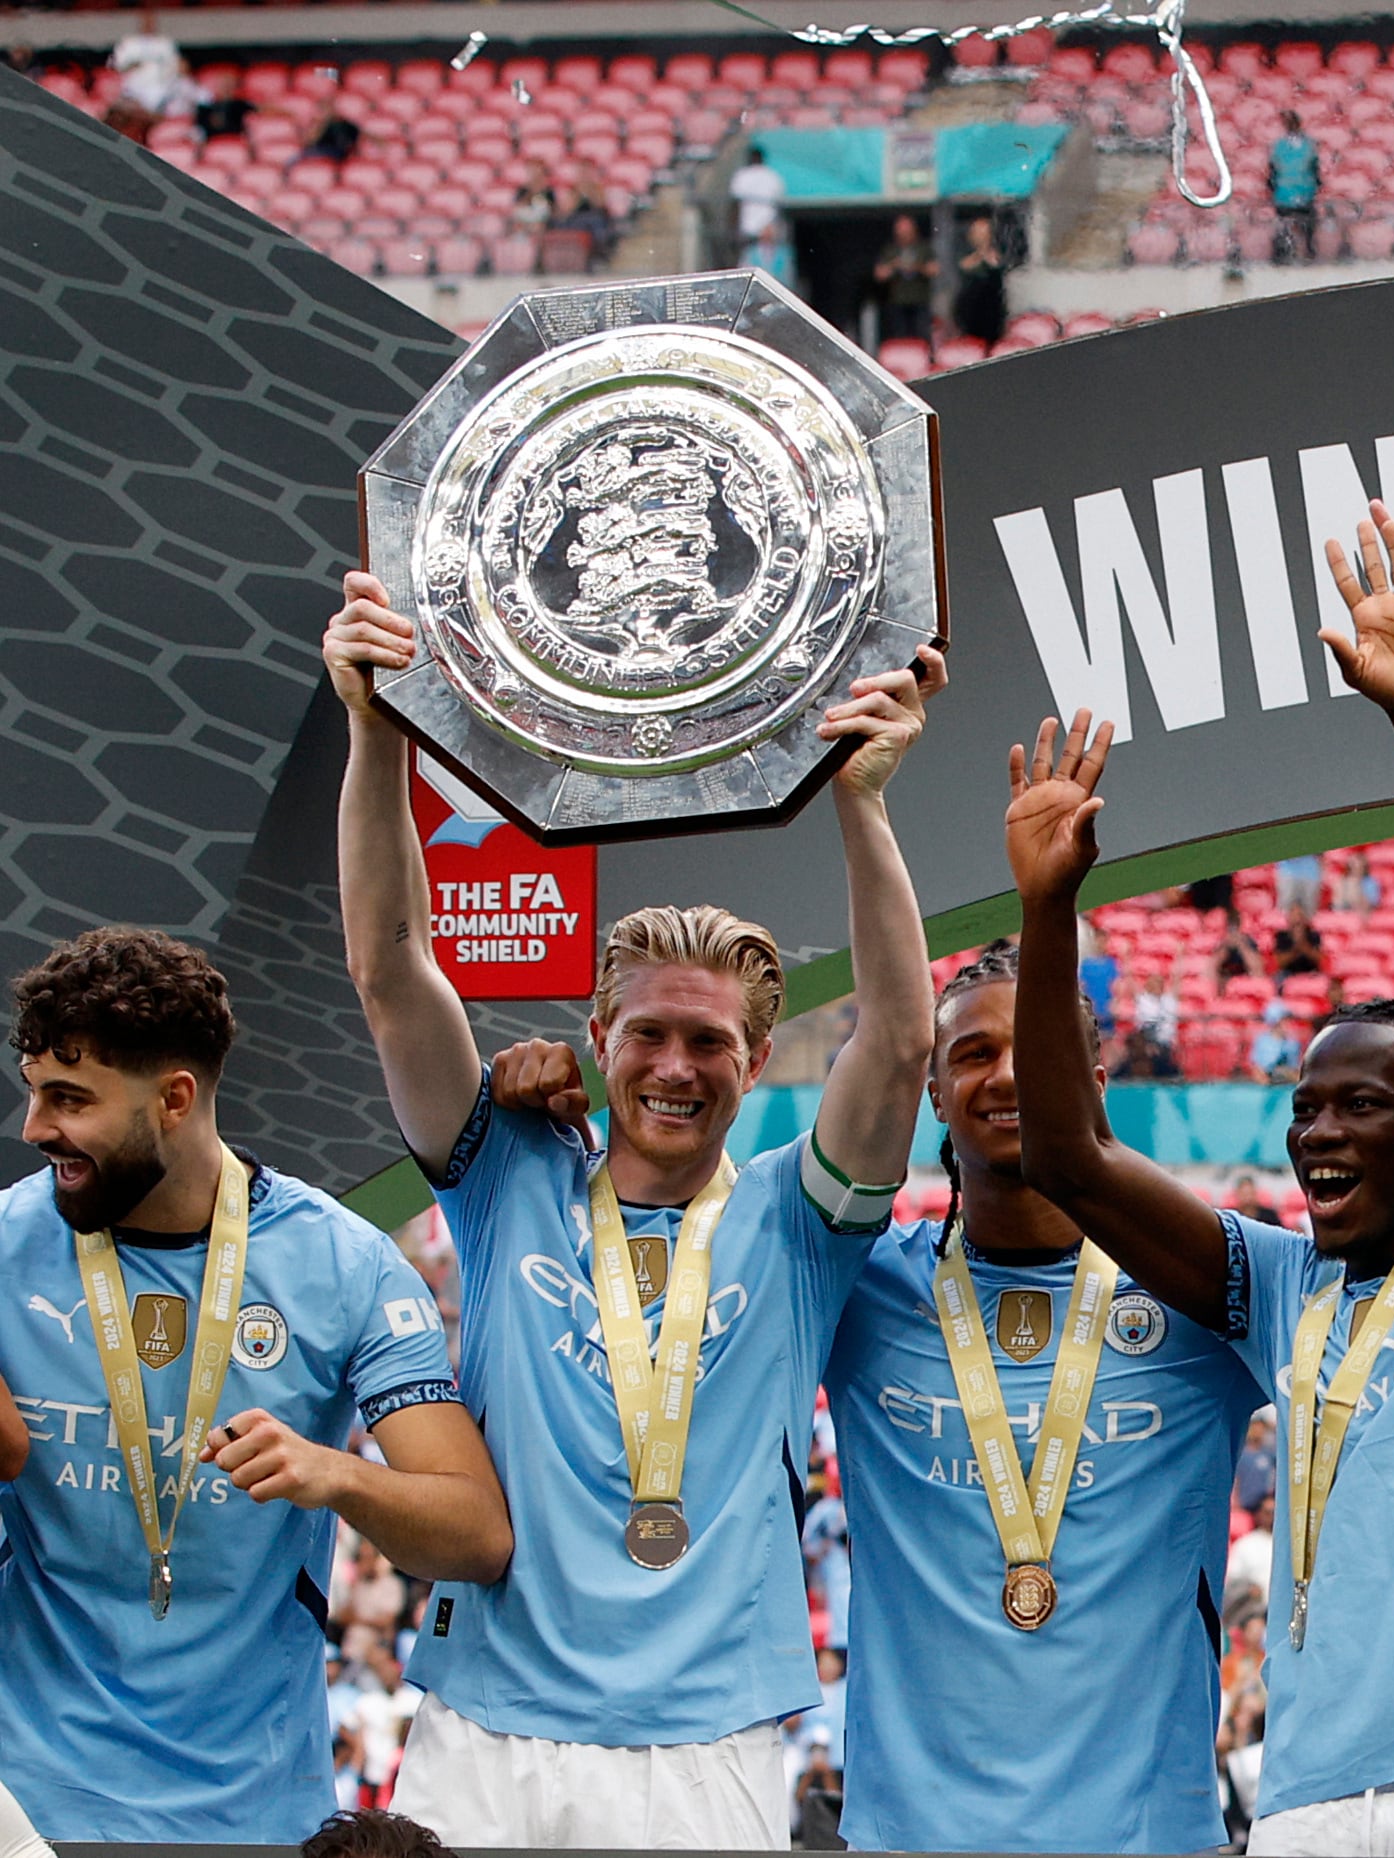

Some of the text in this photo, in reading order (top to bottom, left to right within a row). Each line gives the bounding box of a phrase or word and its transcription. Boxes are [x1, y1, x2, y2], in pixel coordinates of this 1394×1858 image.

[437, 873, 565, 911] THE FA
[456, 939, 547, 963] SHIELD
[604, 1245, 622, 1275] 2024
[92, 1270, 113, 1316] WINNER
[214, 1242, 237, 1322] 2024 WINNER
[610, 1275, 631, 1320] WINNER
[942, 1276, 964, 1316] WINNER
[1080, 1271, 1101, 1313] WINNER
[102, 1319, 121, 1350] 2024
[144, 1340, 170, 1352] FIFA
[953, 1317, 972, 1349] 2024
[1010, 1336, 1036, 1347] FIFA
[1072, 1314, 1091, 1346] 2024
[673, 1340, 689, 1373] 2024
[664, 1375, 685, 1422] WINNER
[190, 1415, 205, 1449] 2024
[1295, 1403, 1306, 1449] WINNER
[55, 1461, 229, 1504] AIRAYS
[130, 1445, 147, 1491] WINNER
[927, 1456, 1095, 1488] AIRS
[984, 1437, 1017, 1517] 2024 WINNER
[1033, 1437, 1064, 1518] 2024 WINNER
